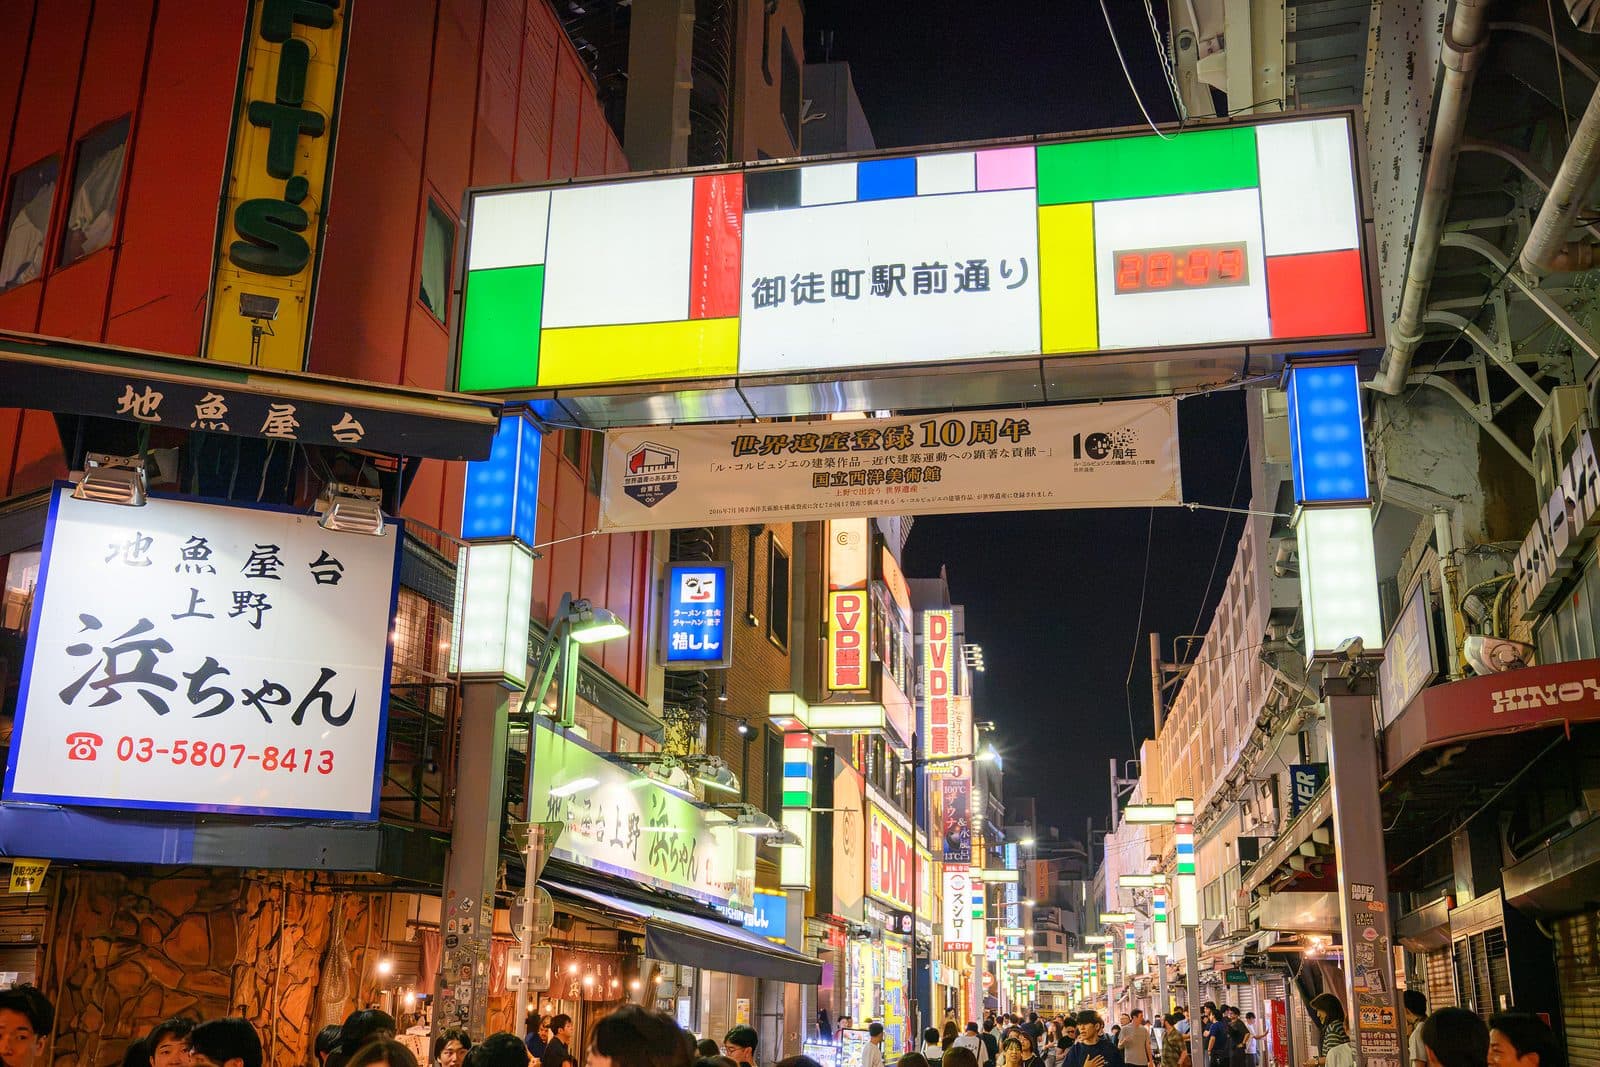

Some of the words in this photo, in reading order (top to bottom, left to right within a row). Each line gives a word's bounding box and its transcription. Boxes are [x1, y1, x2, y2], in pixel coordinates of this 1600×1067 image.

[751, 256, 1030, 311] 御徒町駅前通り
[117, 384, 366, 443] 地魚屋台
[731, 418, 1031, 458] 世界遺産登録10周年
[812, 465, 942, 488] 国立西洋美術館
[105, 530, 346, 587] 地魚屋台
[172, 587, 273, 630] 上野
[672, 632, 720, 651] 福しん
[58, 613, 357, 727] 浜ちゃん
[116, 735, 335, 775] 03-5807-8413
[952, 893, 965, 939] スシロー
